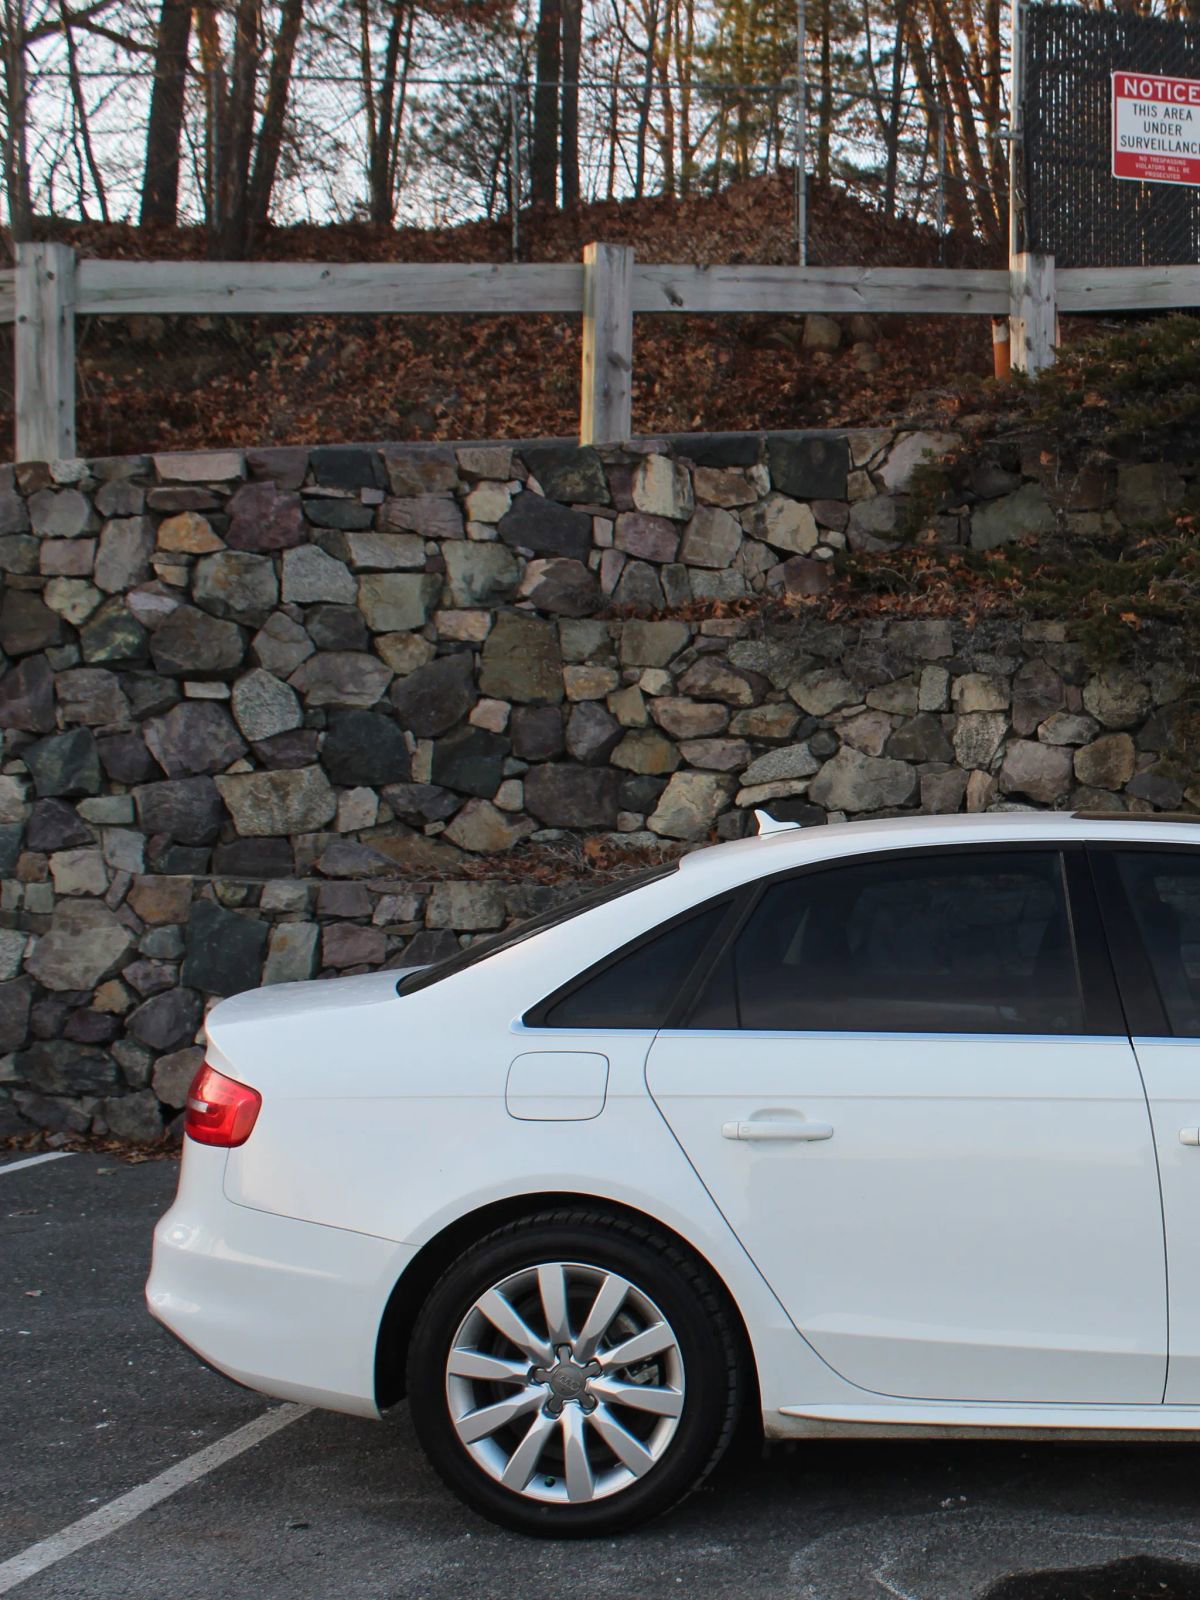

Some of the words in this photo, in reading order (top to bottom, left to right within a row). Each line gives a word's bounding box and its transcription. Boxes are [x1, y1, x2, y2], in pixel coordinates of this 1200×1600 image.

[1124, 78, 1200, 103] NOTICE
[1133, 103, 1157, 118] THIS
[1164, 107, 1193, 121] AREA
[1143, 121, 1182, 136] UNDER
